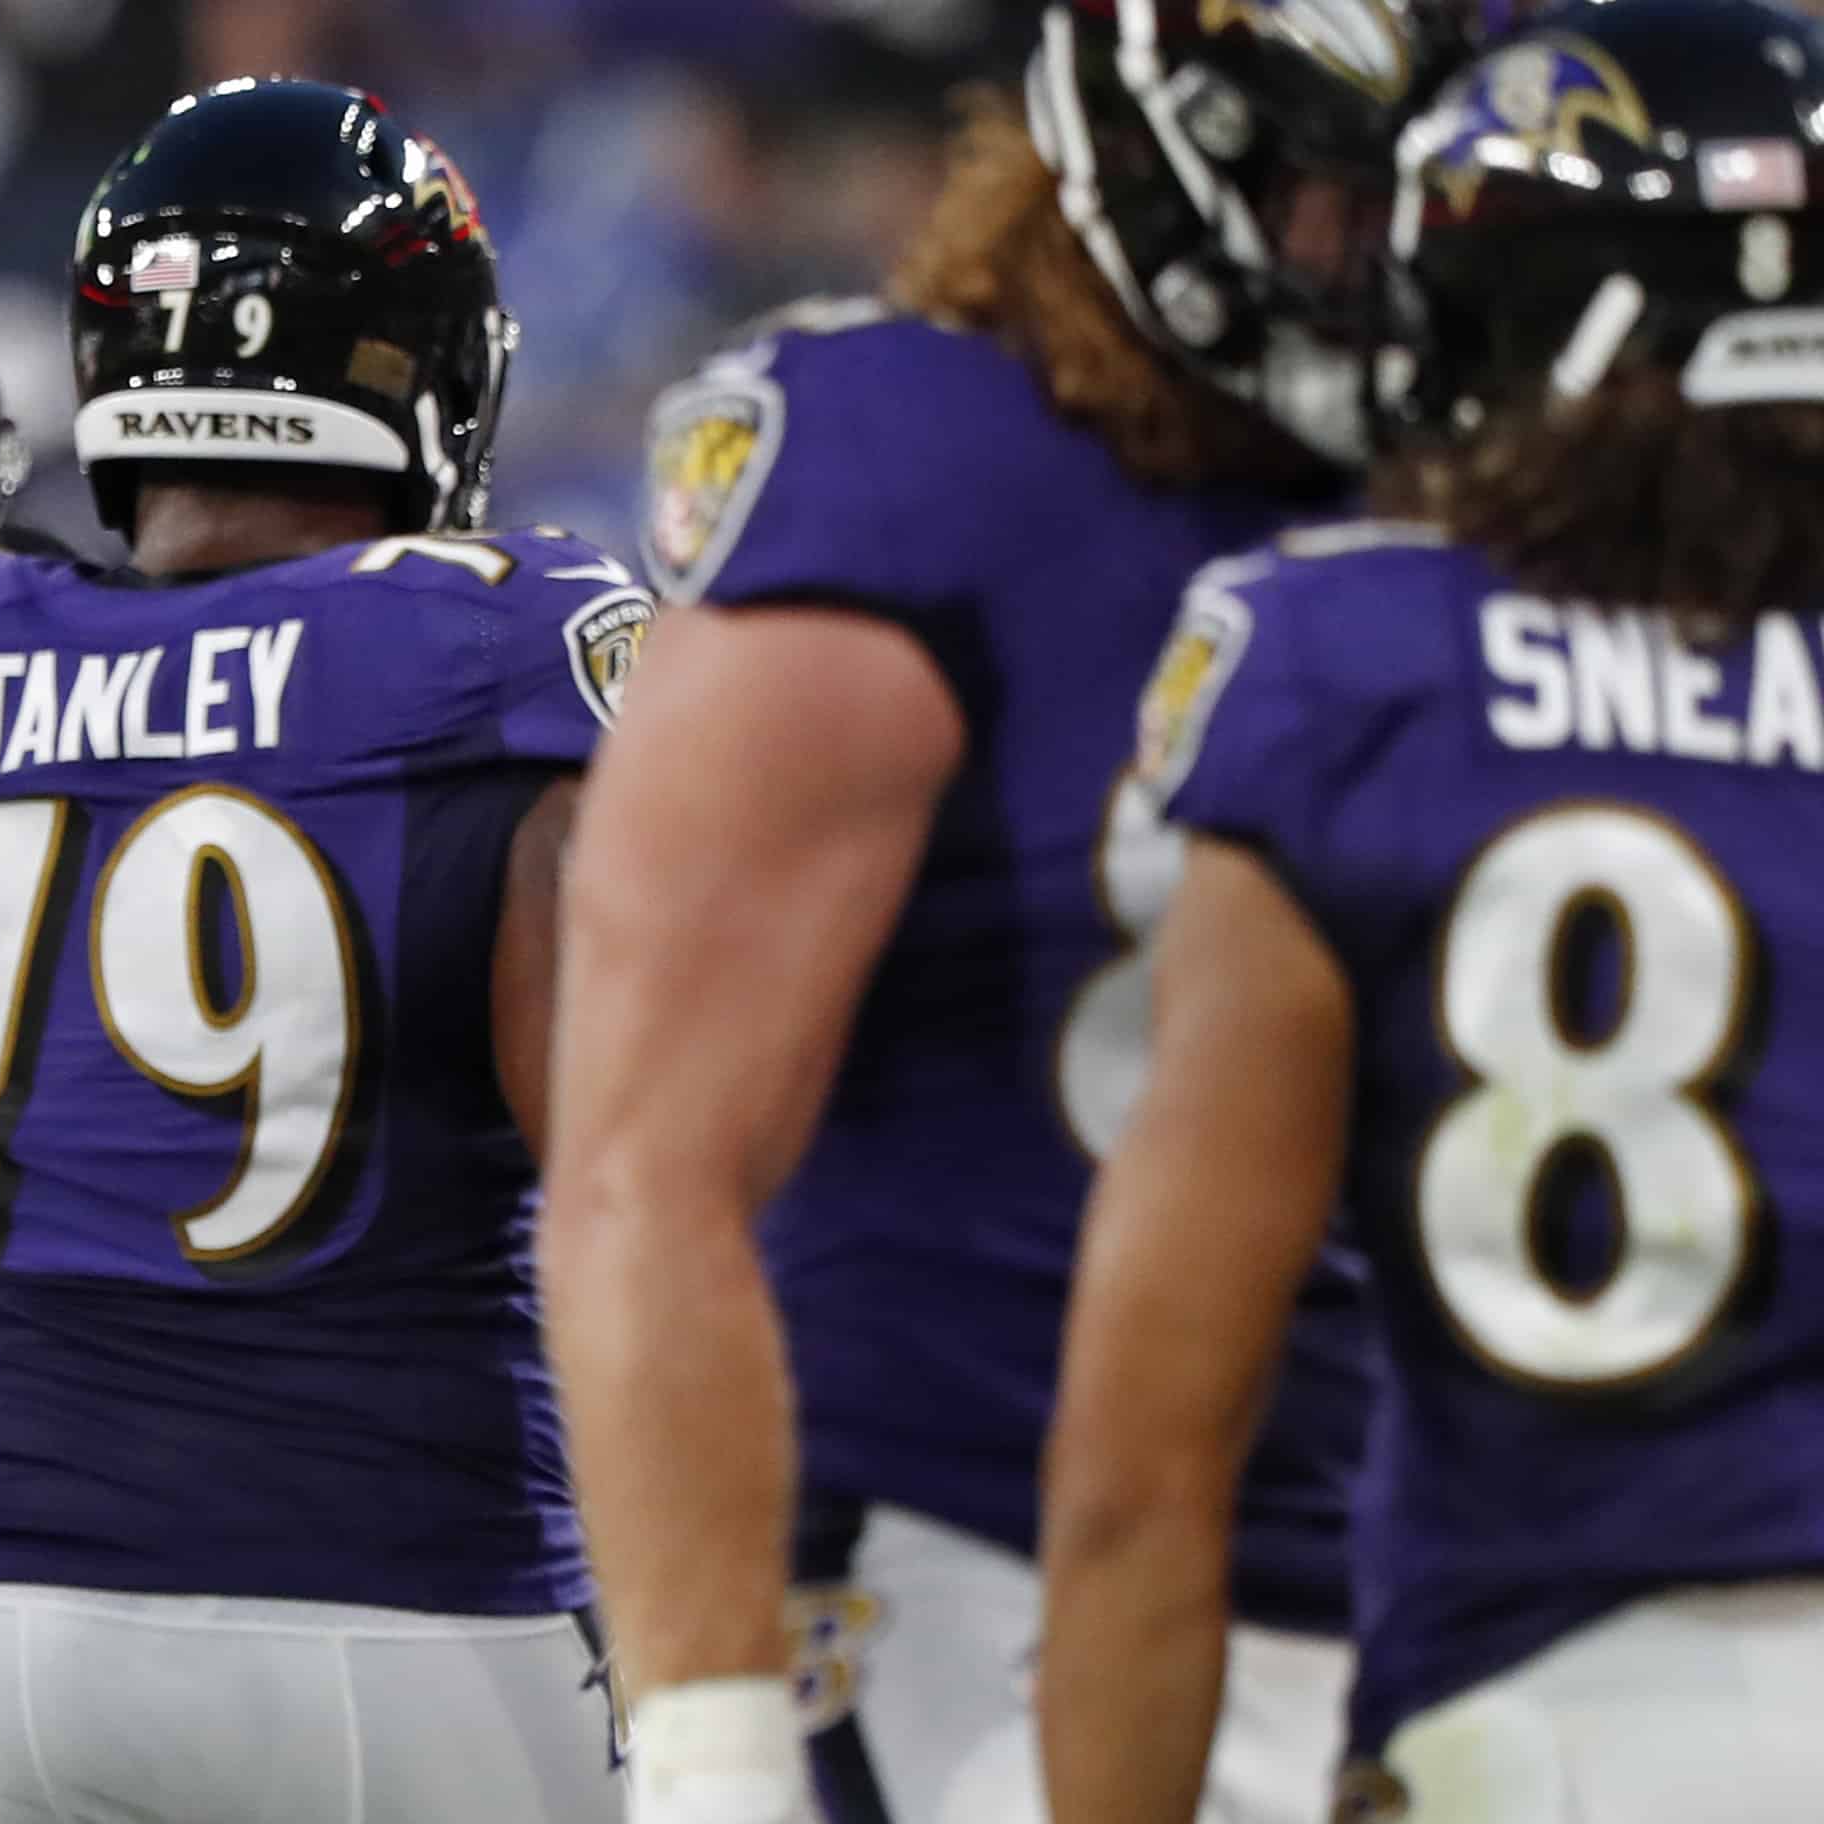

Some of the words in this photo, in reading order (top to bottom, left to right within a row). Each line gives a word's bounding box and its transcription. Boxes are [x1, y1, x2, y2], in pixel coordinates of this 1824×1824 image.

[116, 411, 316, 444] RAVENS
[1478, 594, 1824, 772] SNEA
[1416, 798, 1756, 1388] 8
